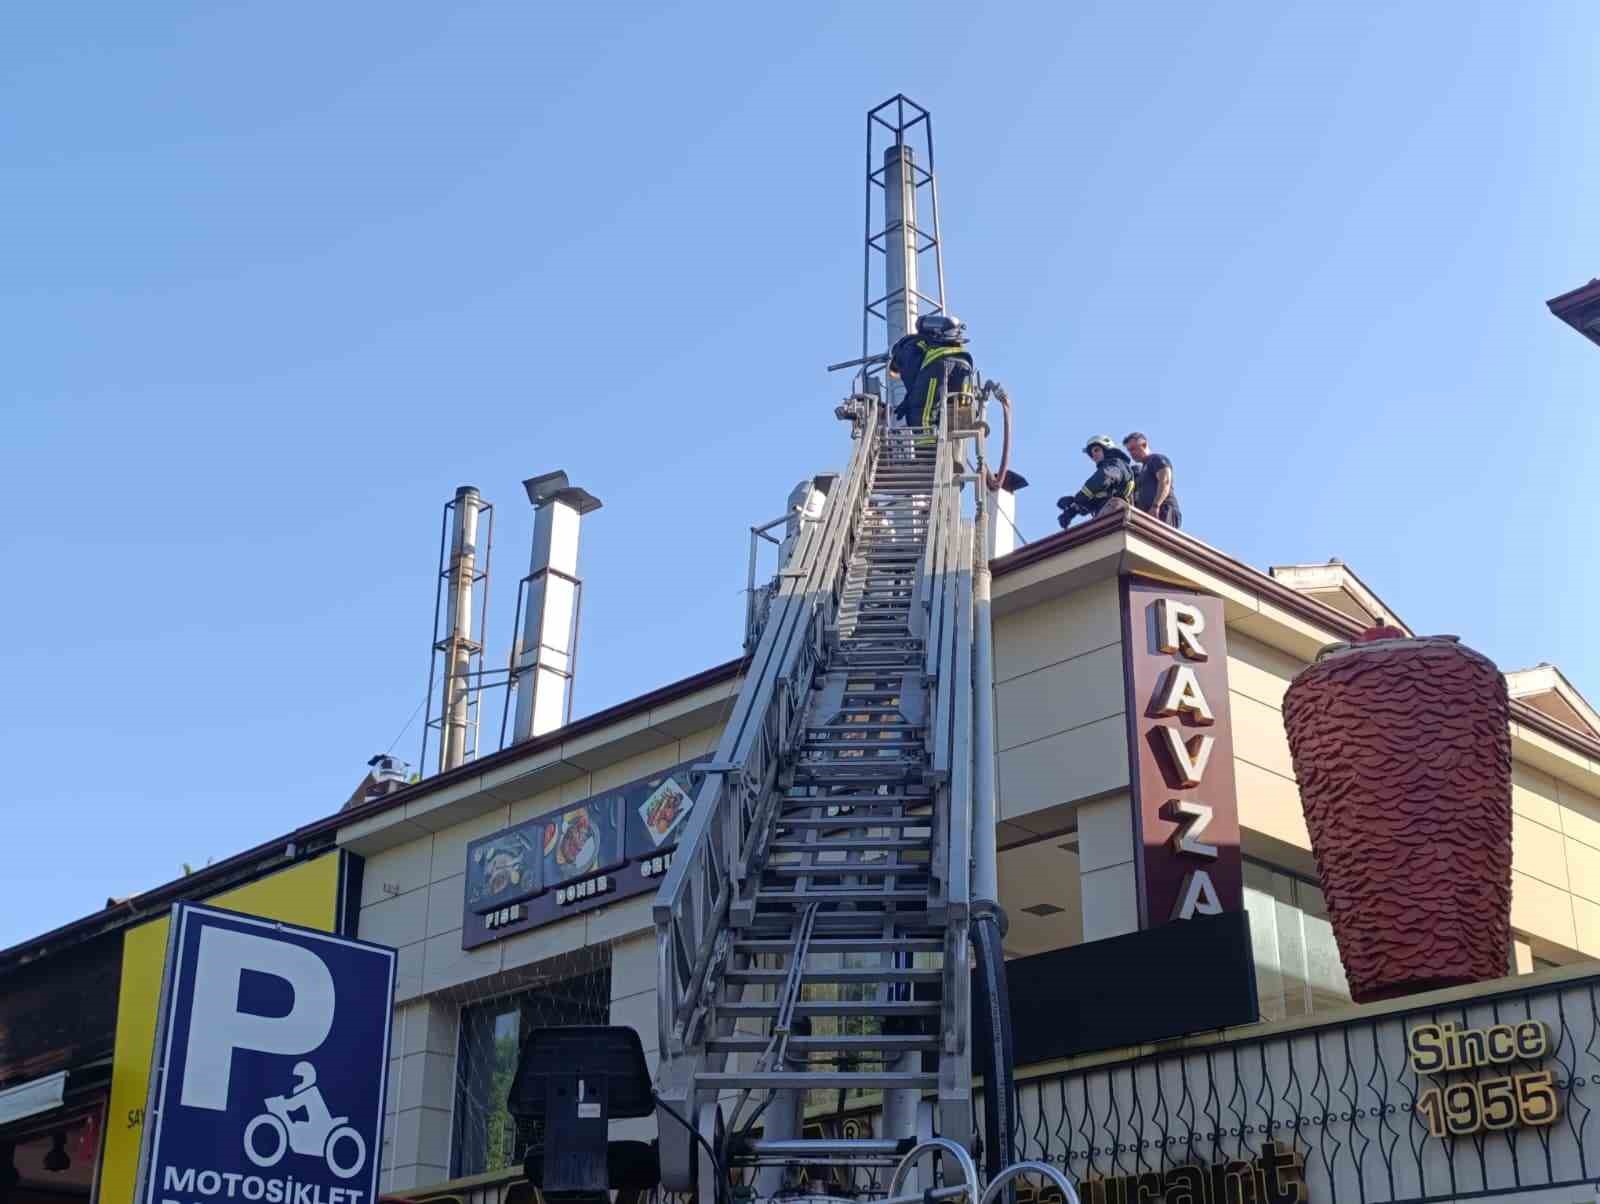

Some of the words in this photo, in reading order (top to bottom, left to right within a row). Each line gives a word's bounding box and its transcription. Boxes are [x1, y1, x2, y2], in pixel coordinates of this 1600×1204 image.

[1150, 598, 1224, 921] RAVZA
[641, 853, 672, 878] GRI
[180, 924, 335, 1112] P
[1407, 1019, 1548, 1076] Since
[1416, 1069, 1559, 1138] 1955
[163, 1165, 364, 1204] MOTOSİKLET
